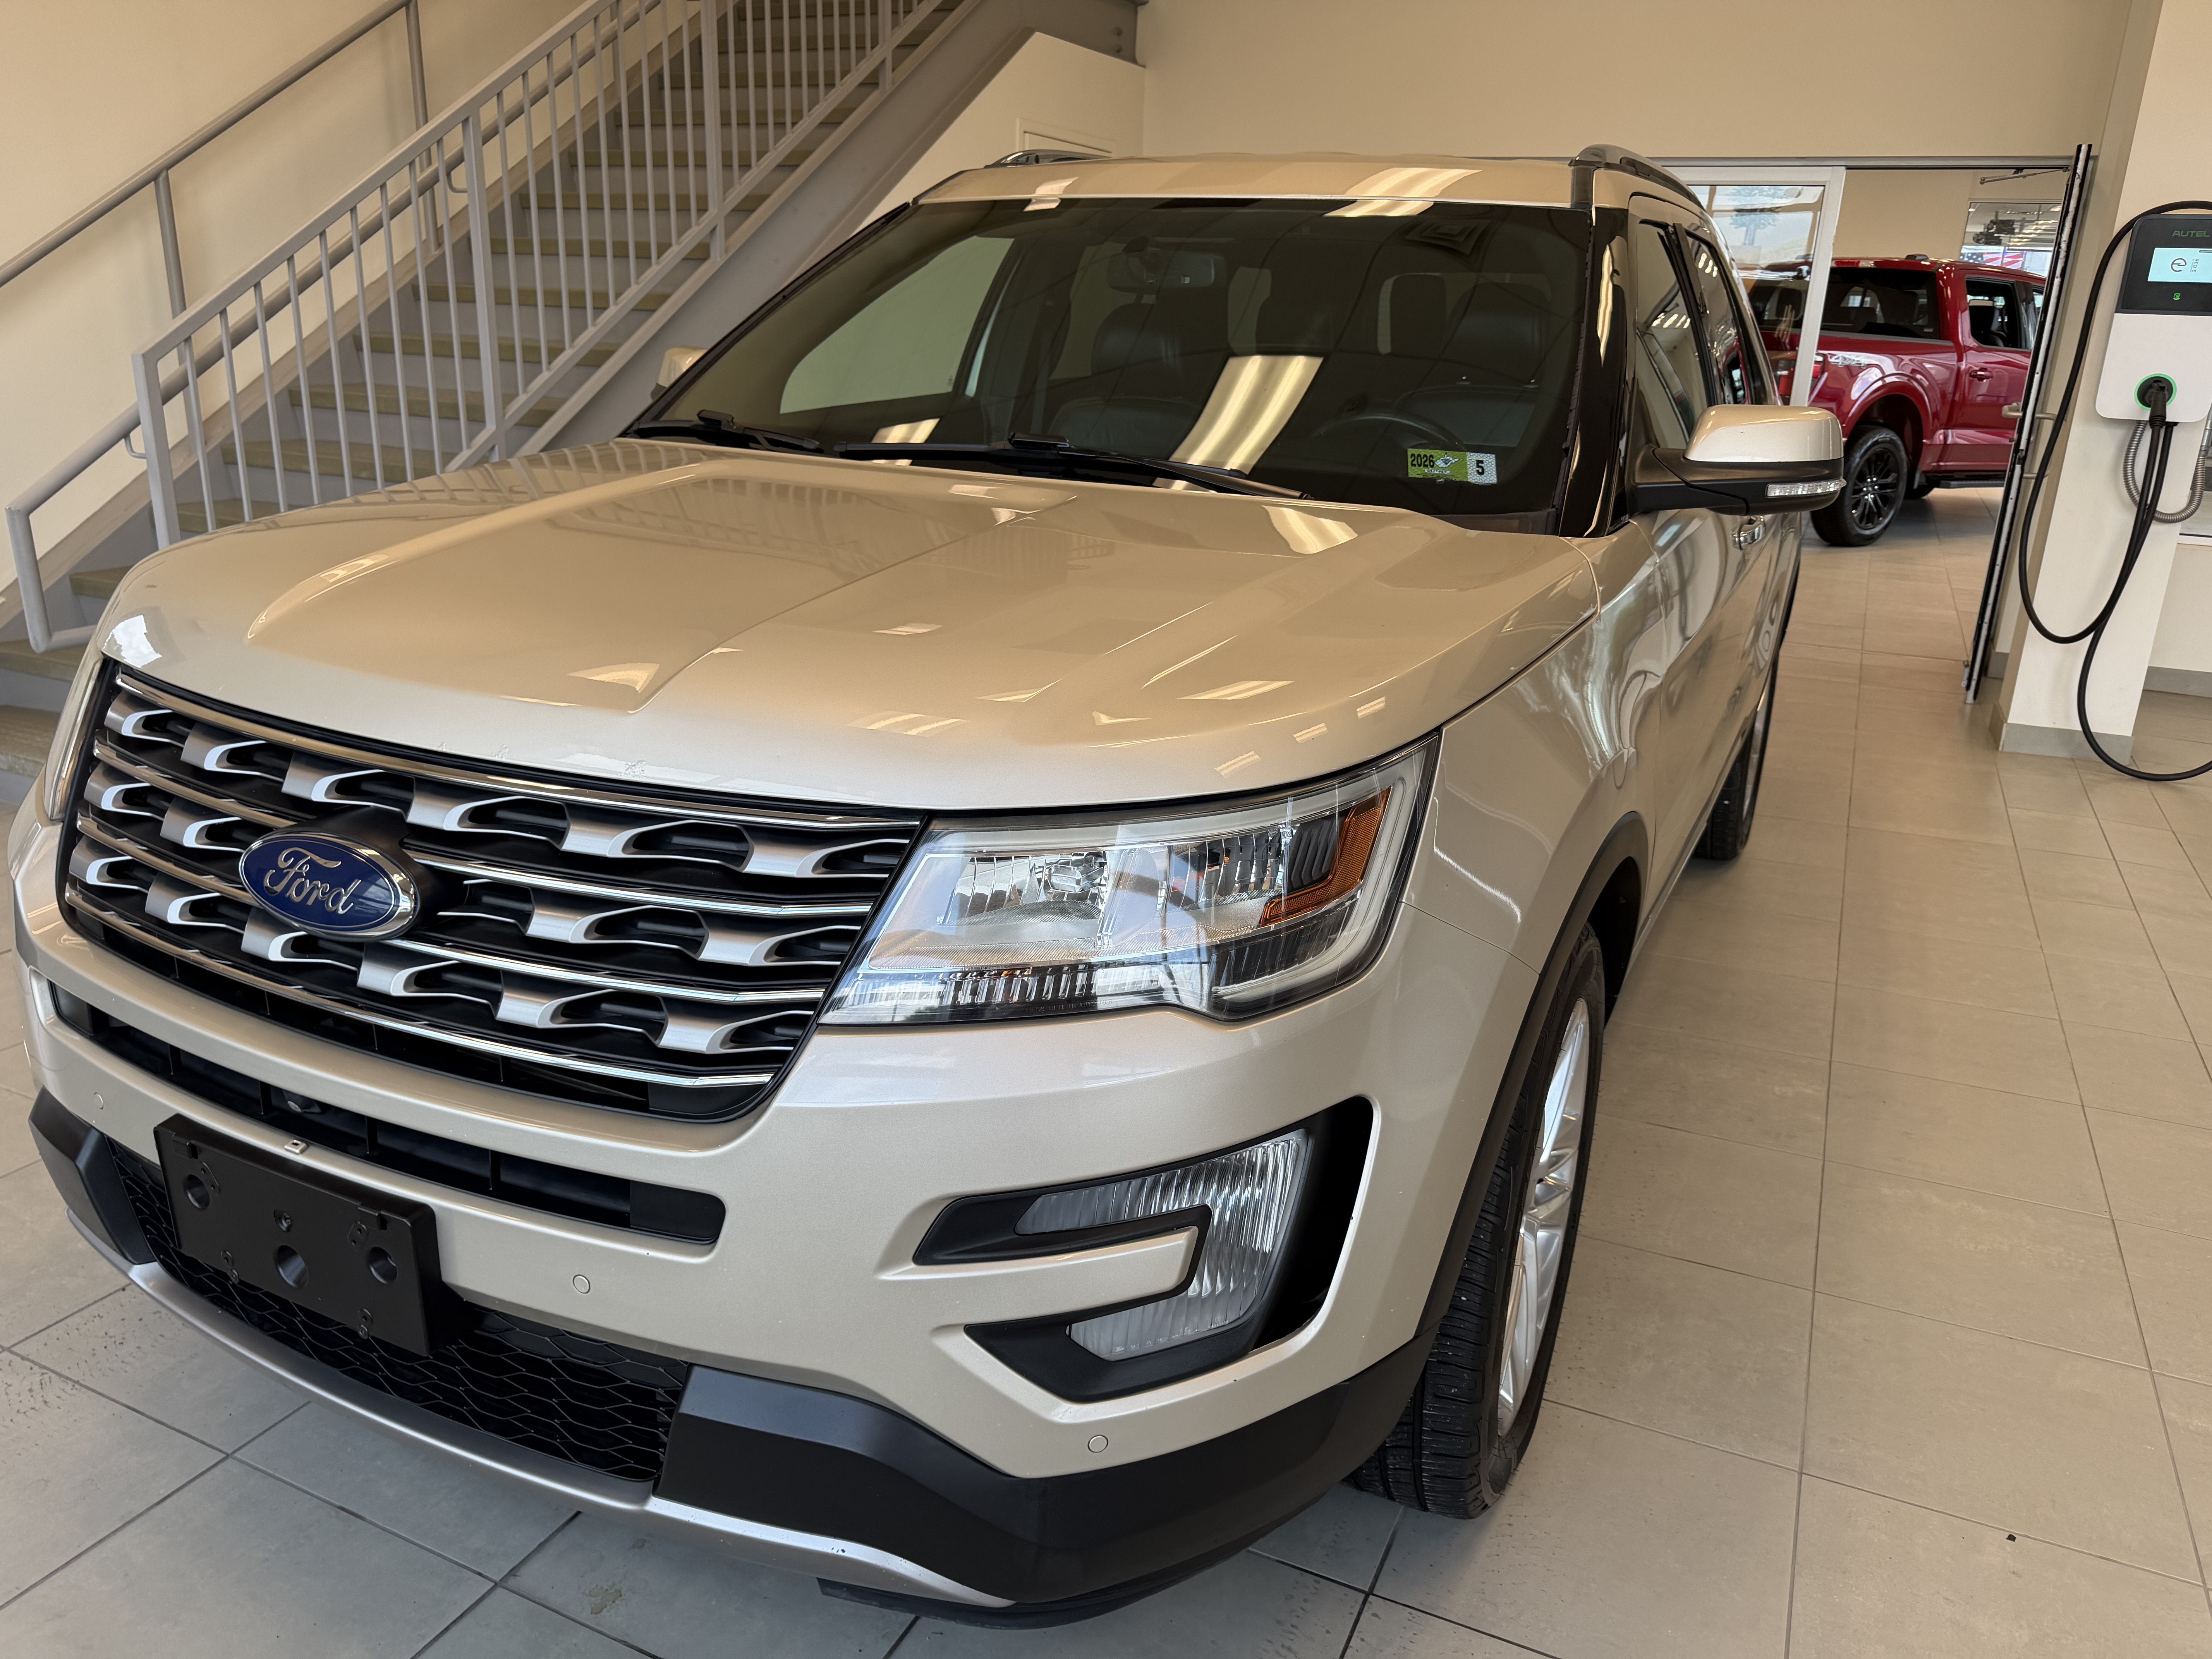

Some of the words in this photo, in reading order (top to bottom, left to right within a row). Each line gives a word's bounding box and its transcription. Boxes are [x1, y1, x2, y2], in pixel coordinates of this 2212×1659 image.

[1410, 453, 1434, 468] 2026
[1475, 459, 1485, 476] 5
[263, 847, 362, 915] Ford
